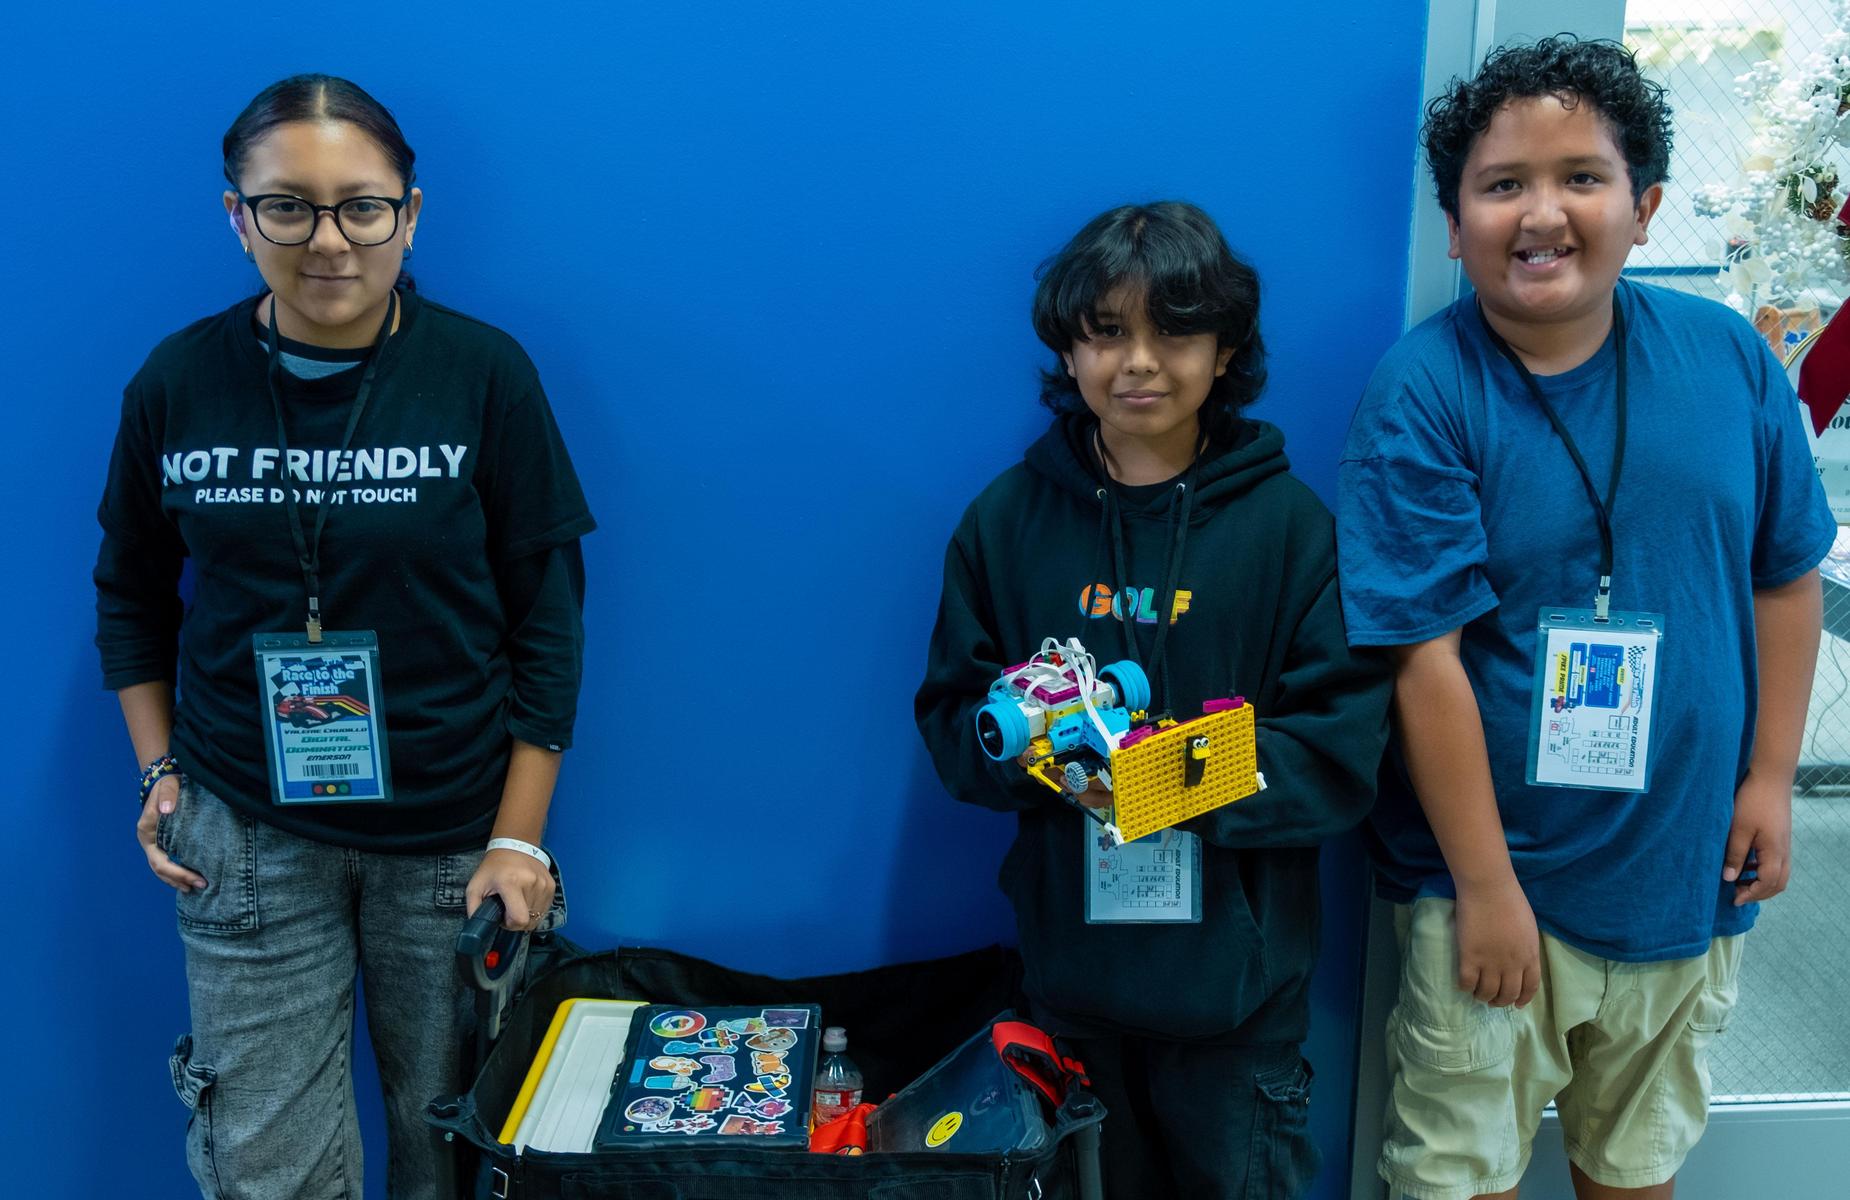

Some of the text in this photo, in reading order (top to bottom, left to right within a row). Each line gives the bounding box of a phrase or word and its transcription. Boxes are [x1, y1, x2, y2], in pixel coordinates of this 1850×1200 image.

[163, 444, 468, 486] NOT FRIENDLY
[195, 488, 264, 504] PLEASE
[352, 487, 417, 503] TOUCH
[1078, 583, 1193, 625] GOLF
[282, 667, 355, 681] Race to the
[301, 682, 339, 695] Finish
[285, 745, 370, 754] DOMINATORS
[1628, 736, 1637, 768] EDUCATION
